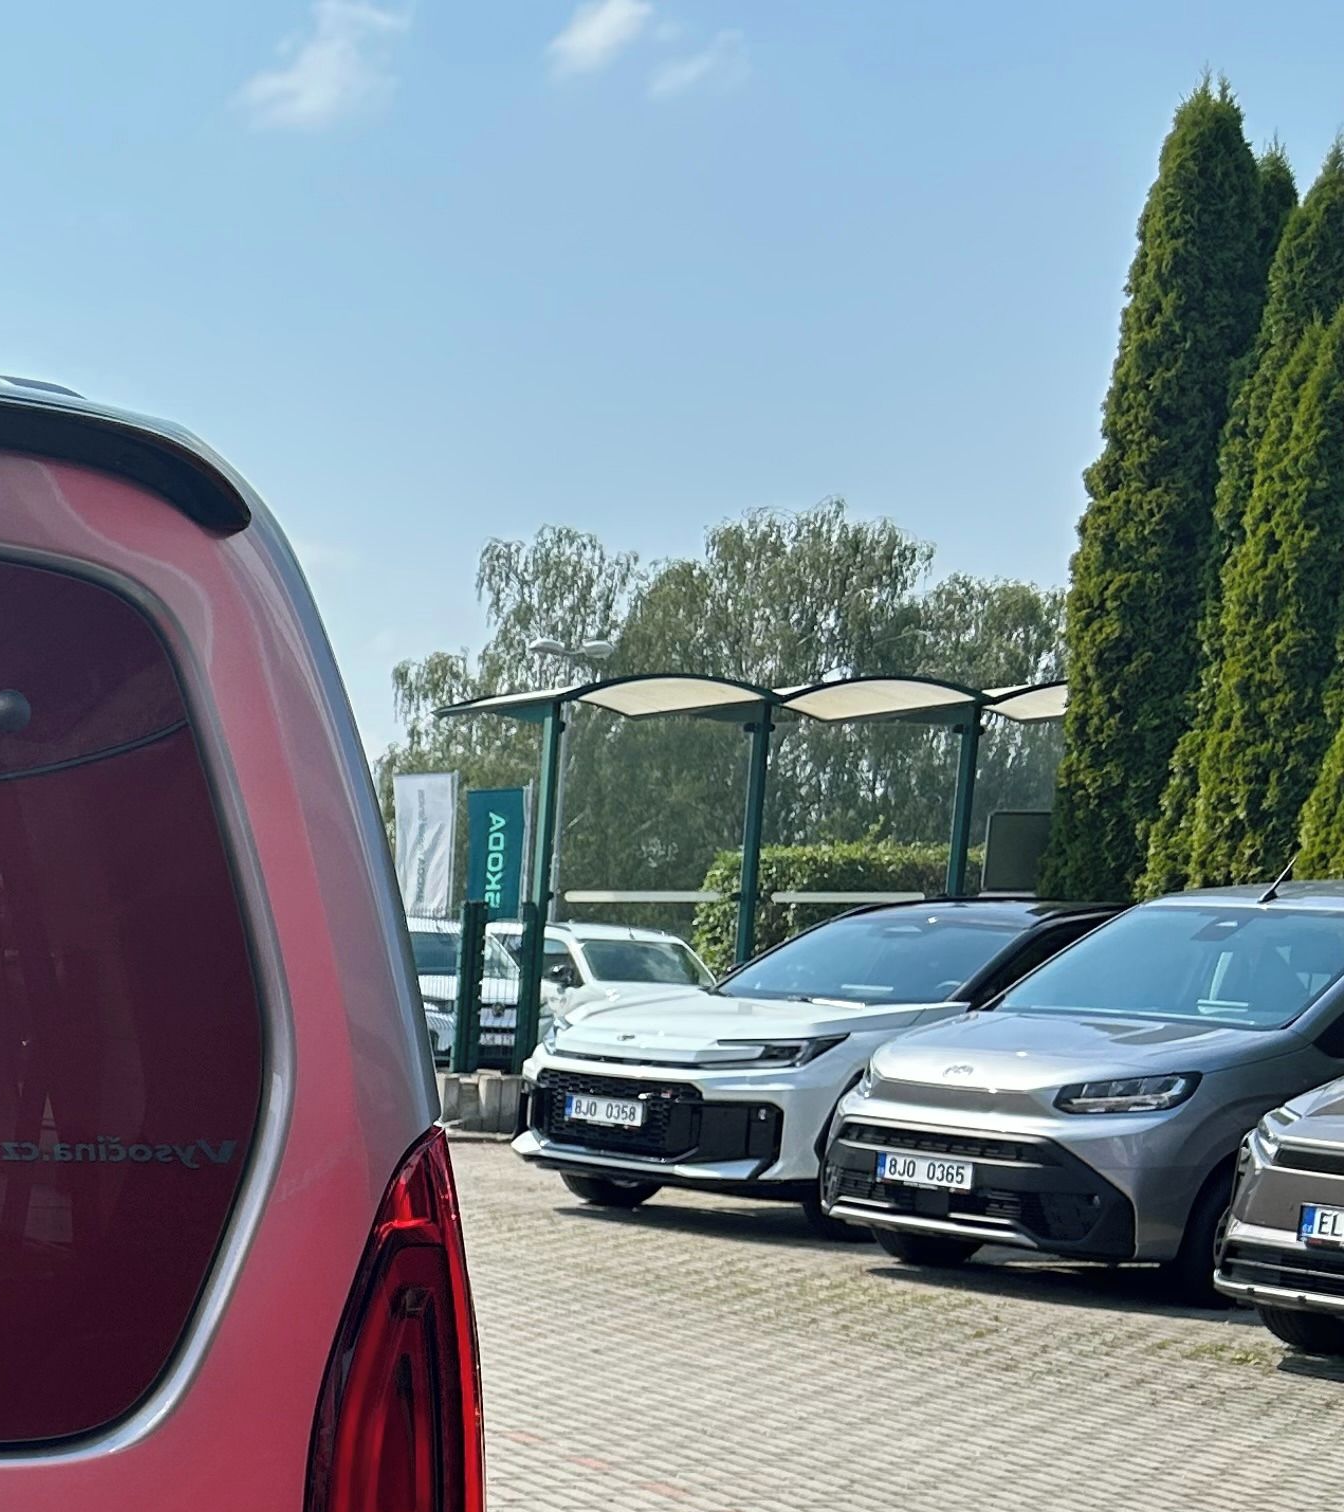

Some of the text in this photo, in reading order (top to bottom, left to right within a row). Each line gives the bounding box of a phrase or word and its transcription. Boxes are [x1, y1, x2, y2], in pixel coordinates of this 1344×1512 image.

[485, 811, 506, 909] ŠKODA
[574, 1099, 637, 1122] 8J0 0358
[888, 1157, 965, 1184] 8J0 0365
